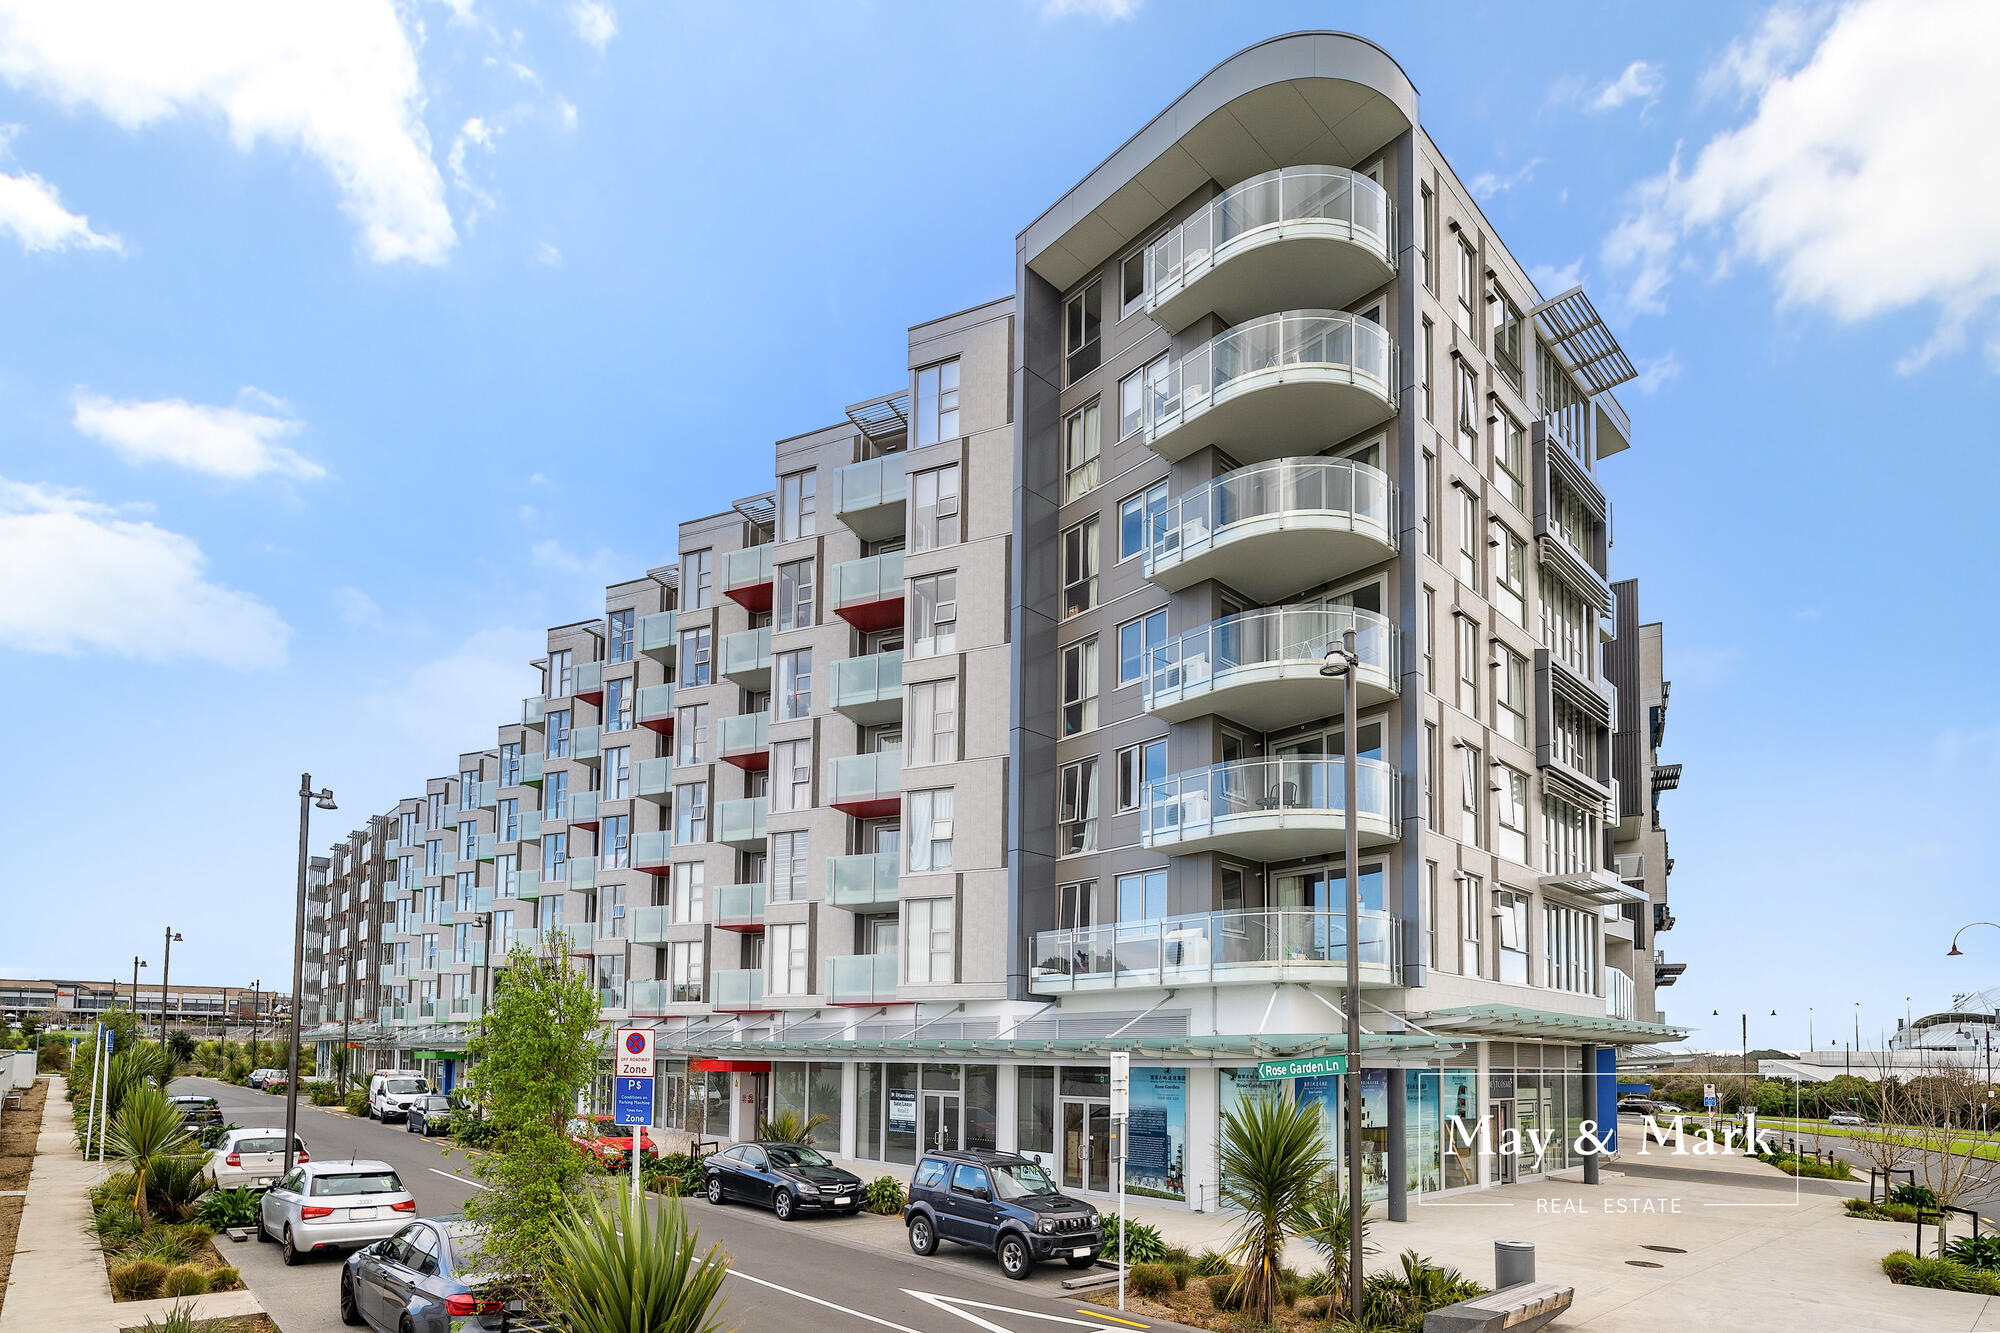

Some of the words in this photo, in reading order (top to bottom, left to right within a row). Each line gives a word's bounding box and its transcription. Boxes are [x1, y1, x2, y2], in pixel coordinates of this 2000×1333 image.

[623, 1064, 647, 1074] Zone
[1265, 1065, 1287, 1077] Rose
[1289, 1061, 1324, 1075] Garden
[1326, 1060, 1340, 1072] Ln
[628, 1079, 642, 1091] P$
[625, 1114, 645, 1123] Zone
